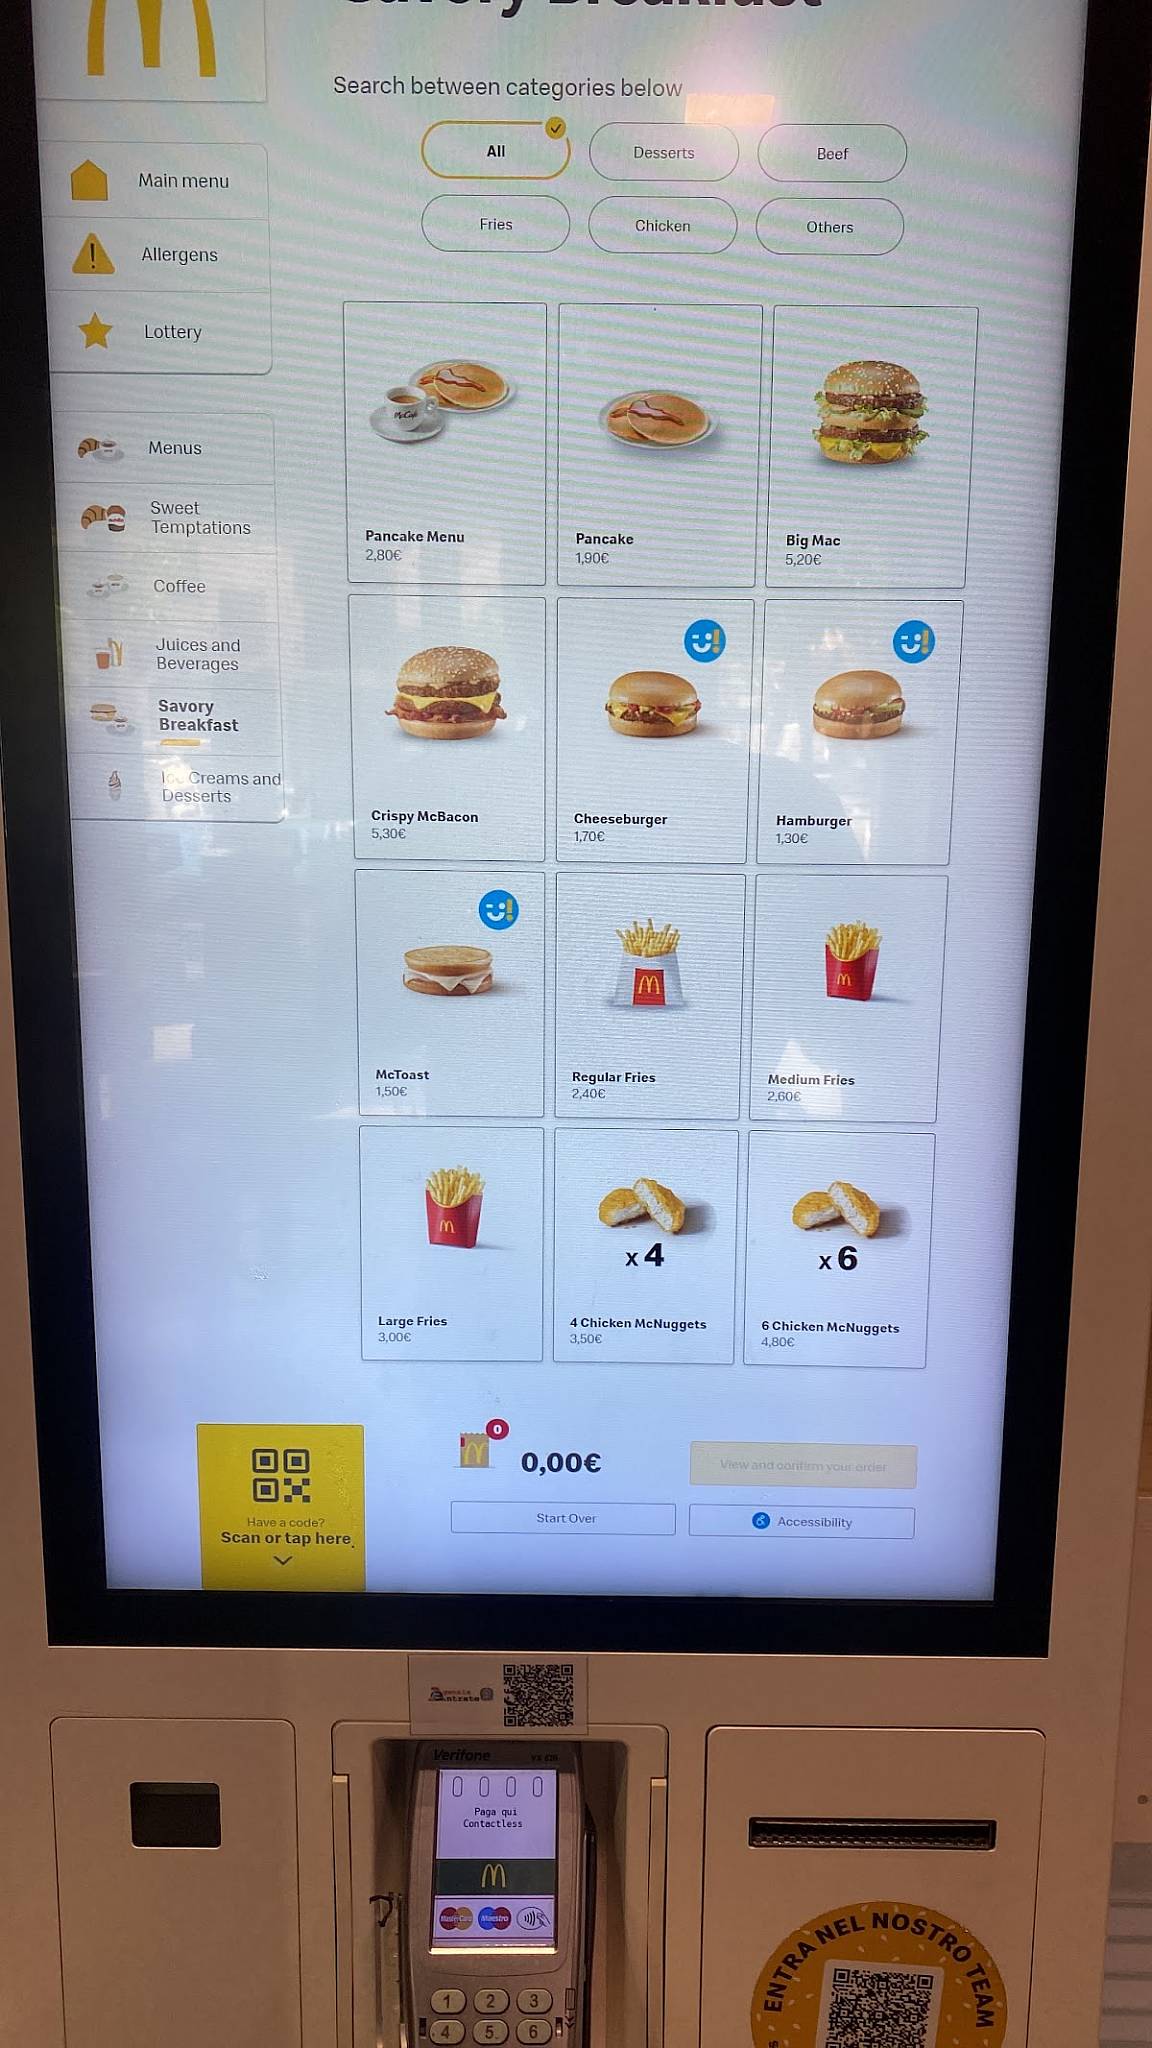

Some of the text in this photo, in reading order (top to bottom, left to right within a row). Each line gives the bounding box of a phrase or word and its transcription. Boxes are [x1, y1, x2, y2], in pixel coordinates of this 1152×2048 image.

[333, 75, 683, 102] Search between categories below
[486, 144, 505, 158] All
[633, 145, 695, 160] Desserts
[817, 147, 849, 161] Beef
[138, 172, 229, 189] Main menu
[480, 217, 513, 231] Fries
[635, 219, 691, 233] Chicken
[806, 220, 854, 234] Others
[141, 246, 218, 266] Allergens
[145, 324, 202, 344] Lottery
[148, 440, 202, 455] Menus
[150, 500, 200, 515] Sweet
[151, 519, 251, 538] Temptations
[365, 530, 465, 543] Pancake Menu
[576, 532, 634, 545] Pancake
[786, 533, 841, 550] Big Mac
[365, 548, 403, 563] 2,80€
[575, 551, 609, 566] 1,90€
[785, 553, 822, 568] 5,20€
[153, 579, 206, 594] Coffee
[155, 637, 241, 652] Juices and
[156, 656, 239, 674] Beverages
[158, 699, 215, 717] Savory
[159, 717, 240, 732] Breakfast
[189, 771, 250, 786] Creams
[252, 772, 281, 786] and
[162, 788, 232, 804] Desserts
[371, 809, 479, 825] Crispy McBacon
[573, 812, 668, 829] Cheeseburger
[776, 815, 853, 830] Hamburger
[371, 827, 407, 841] 5,30€
[574, 830, 605, 843] 1,70€
[775, 832, 809, 845] 1,30€
[375, 1069, 430, 1080] McToast
[572, 1071, 656, 1086] Regular Fries
[767, 1073, 856, 1086] Medium Fries
[375, 1086, 408, 1098] 1,50€
[571, 1088, 606, 1100] 2,40€
[767, 1090, 801, 1103] 2,60€
[643, 1242, 665, 1267] 4
[837, 1245, 858, 1271] 6
[378, 1315, 448, 1329] Large Fries
[569, 1317, 707, 1333] 4 Chicken McNuggets
[761, 1320, 900, 1336] 6 Chicken McNuggets
[378, 1331, 412, 1344] 3,00€
[569, 1333, 603, 1345] 3,50€
[760, 1336, 795, 1348] 4,80€
[521, 1452, 602, 1477] 0,00€
[720, 1459, 749, 1470] View
[751, 1459, 773, 1470] and
[825, 1462, 851, 1473] your
[247, 1516, 325, 1528] Have a code?
[536, 1512, 597, 1524] Start Over
[777, 1515, 853, 1531] Accessibility
[221, 1531, 261, 1544] Scan
[264, 1534, 282, 1544] or
[284, 1532, 312, 1548] tap
[433, 1748, 491, 1762] Verifone
[474, 1807, 518, 1819] Paga qui
[463, 1818, 523, 1828] Contactless
[764, 1912, 995, 2029] ENTRA NEL NOSTRO TEAM
[443, 1993, 539, 2009] 1 2 3
[440, 2024, 538, 2040] 4 5 6
